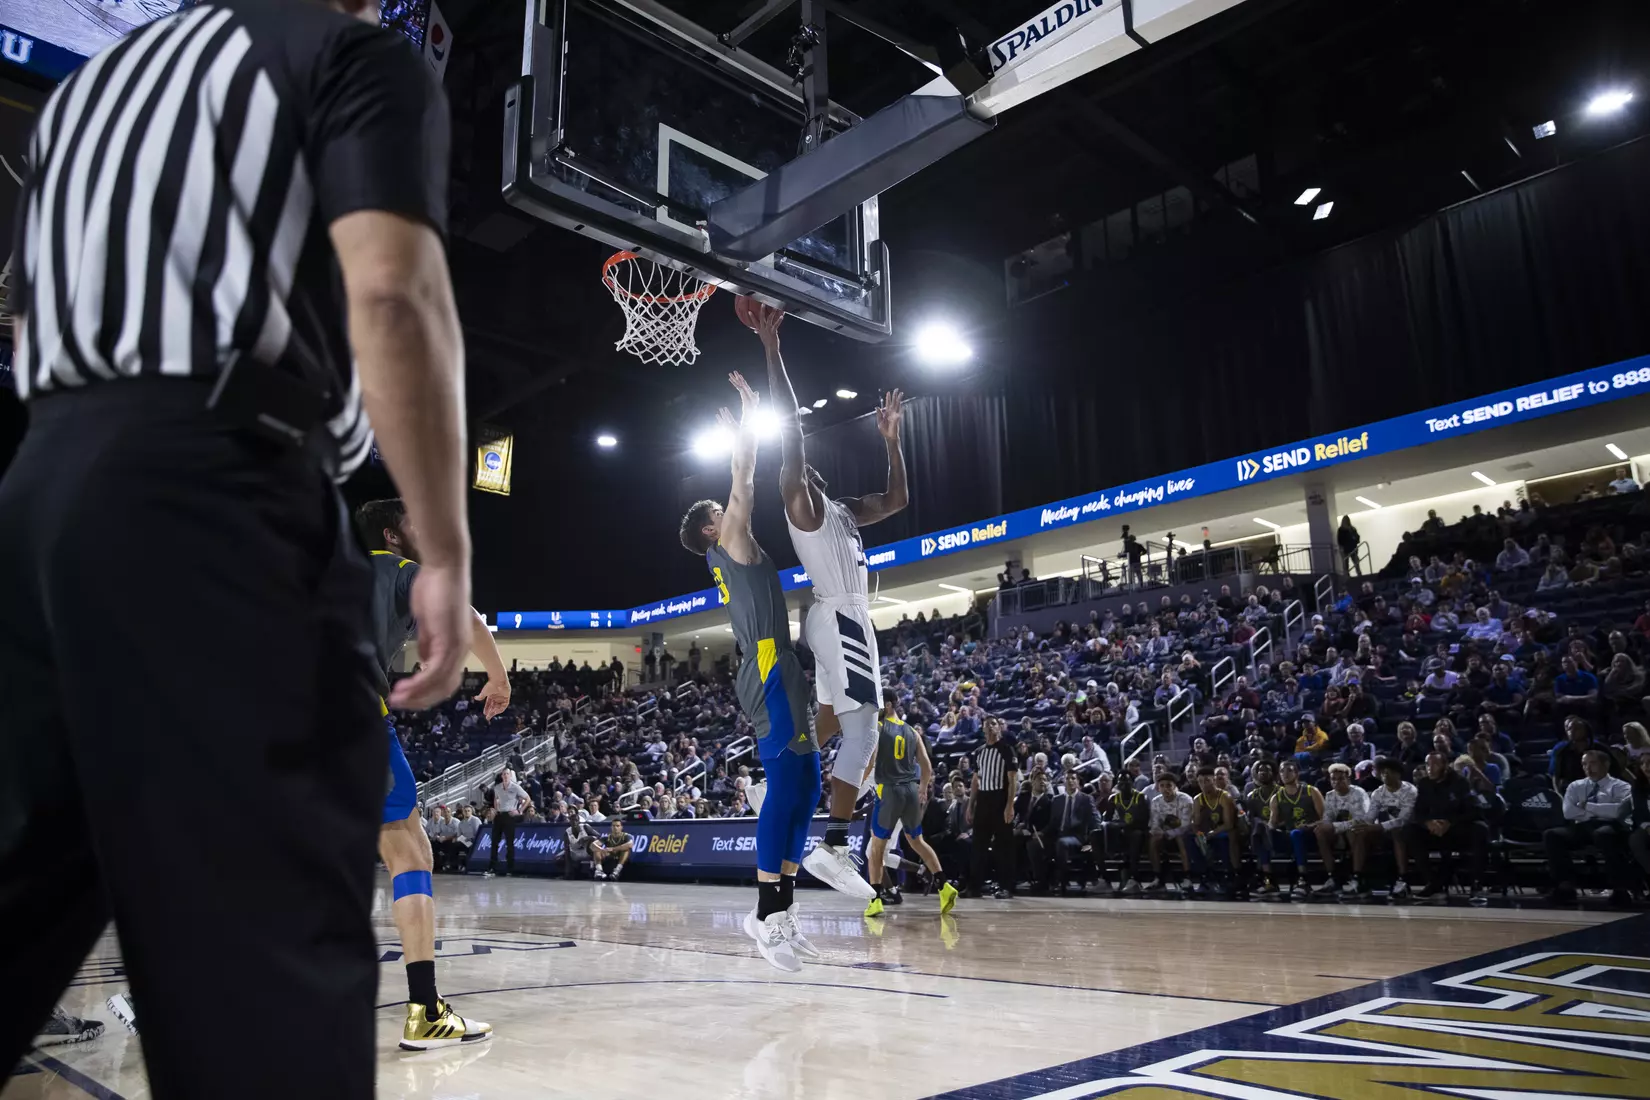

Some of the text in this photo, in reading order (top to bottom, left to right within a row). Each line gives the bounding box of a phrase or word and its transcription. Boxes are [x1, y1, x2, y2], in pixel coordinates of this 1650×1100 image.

[1425, 414, 1461, 432] Text
[1462, 401, 1514, 424] SEND
[1516, 383, 1584, 412] RELIEF
[1588, 381, 1610, 394] to
[1262, 431, 1369, 473] SEND Relief
[938, 520, 1007, 551] SEND Relief
[514, 613, 522, 629] 9
[894, 735, 905, 760] 0
[631, 834, 690, 853] ND Relief
[712, 836, 758, 851] Text SEN
